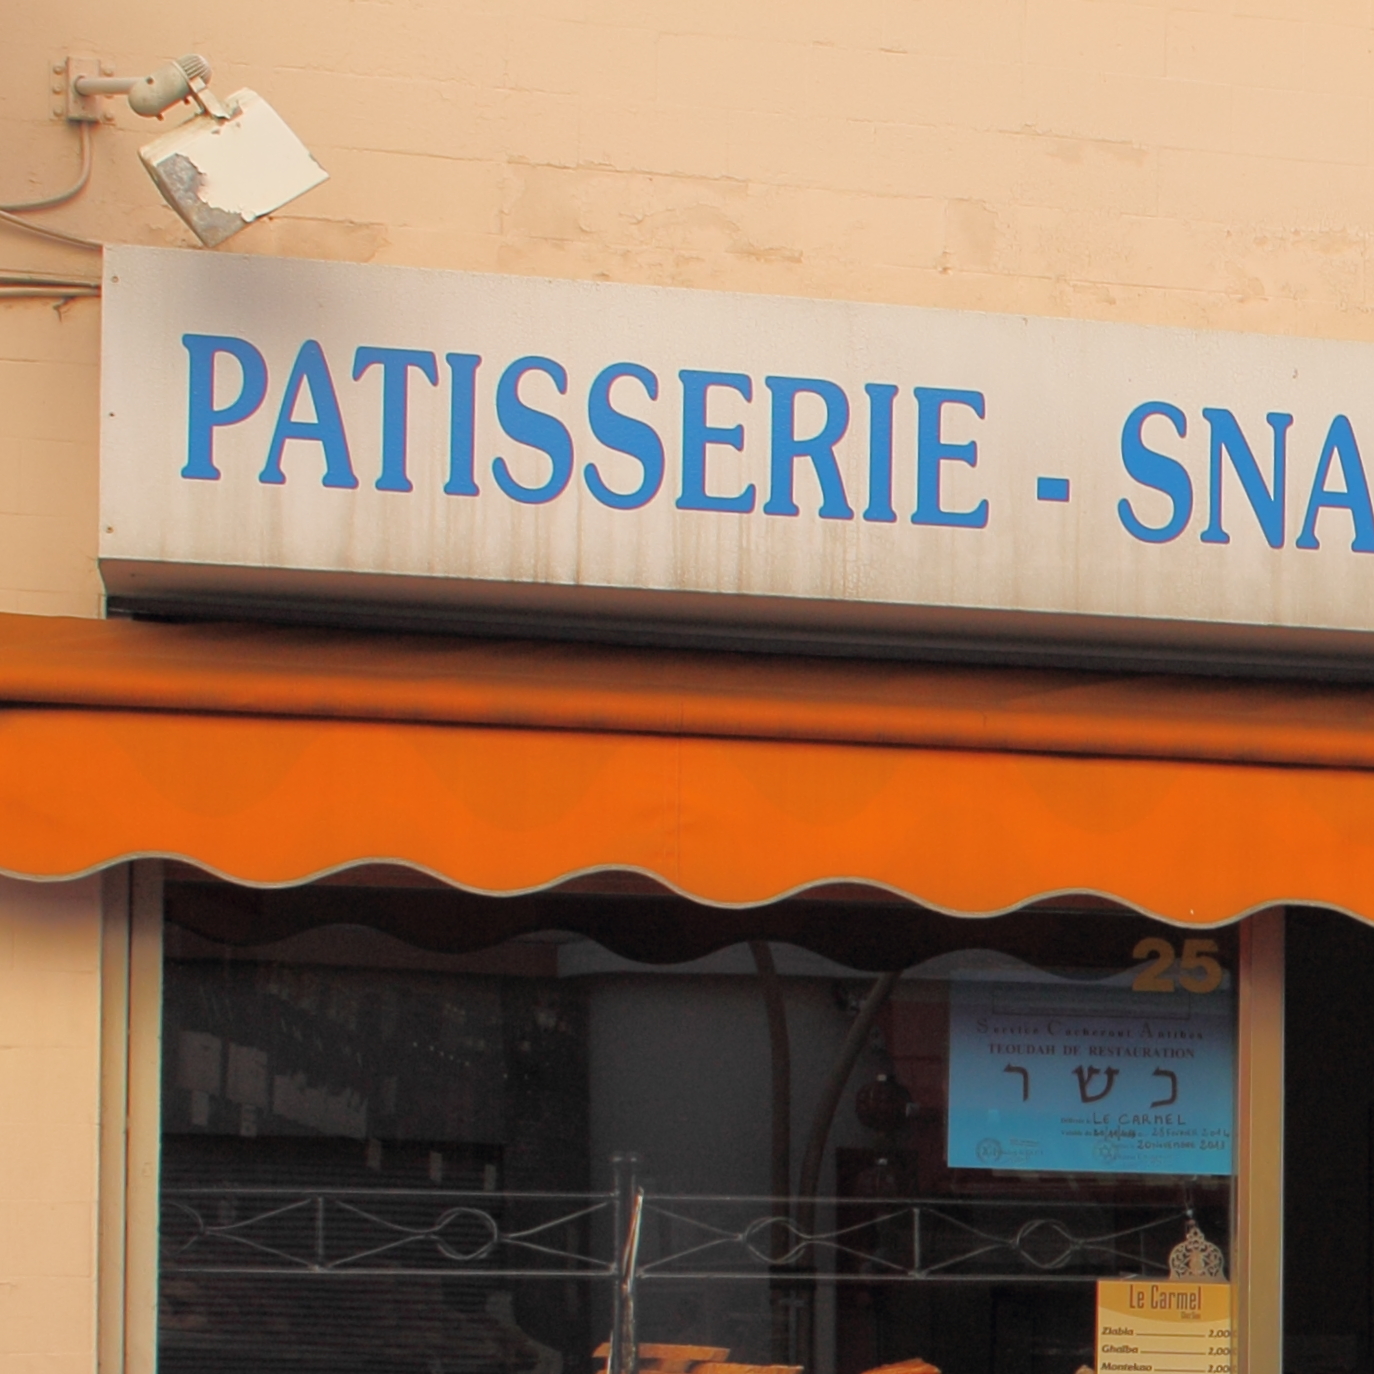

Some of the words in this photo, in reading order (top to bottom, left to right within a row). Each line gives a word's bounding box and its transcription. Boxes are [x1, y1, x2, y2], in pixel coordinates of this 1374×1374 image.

[180, 333, 988, 528] PATISSERIE
[1131, 937, 1223, 994] 25
[977, 1018, 1039, 1035] Service
[1140, 1021, 1204, 1040] Antibes
[988, 1043, 1056, 1056] TEOUDAH
[1063, 1044, 1081, 1057] DE
[1089, 1044, 1195, 1059] RESTAURATION
[1093, 1112, 1110, 1126] LE
[1118, 1112, 1187, 1126] CARMEL
[1129, 1284, 1145, 1309] Le
[1150, 1284, 1202, 1311] Carmel
